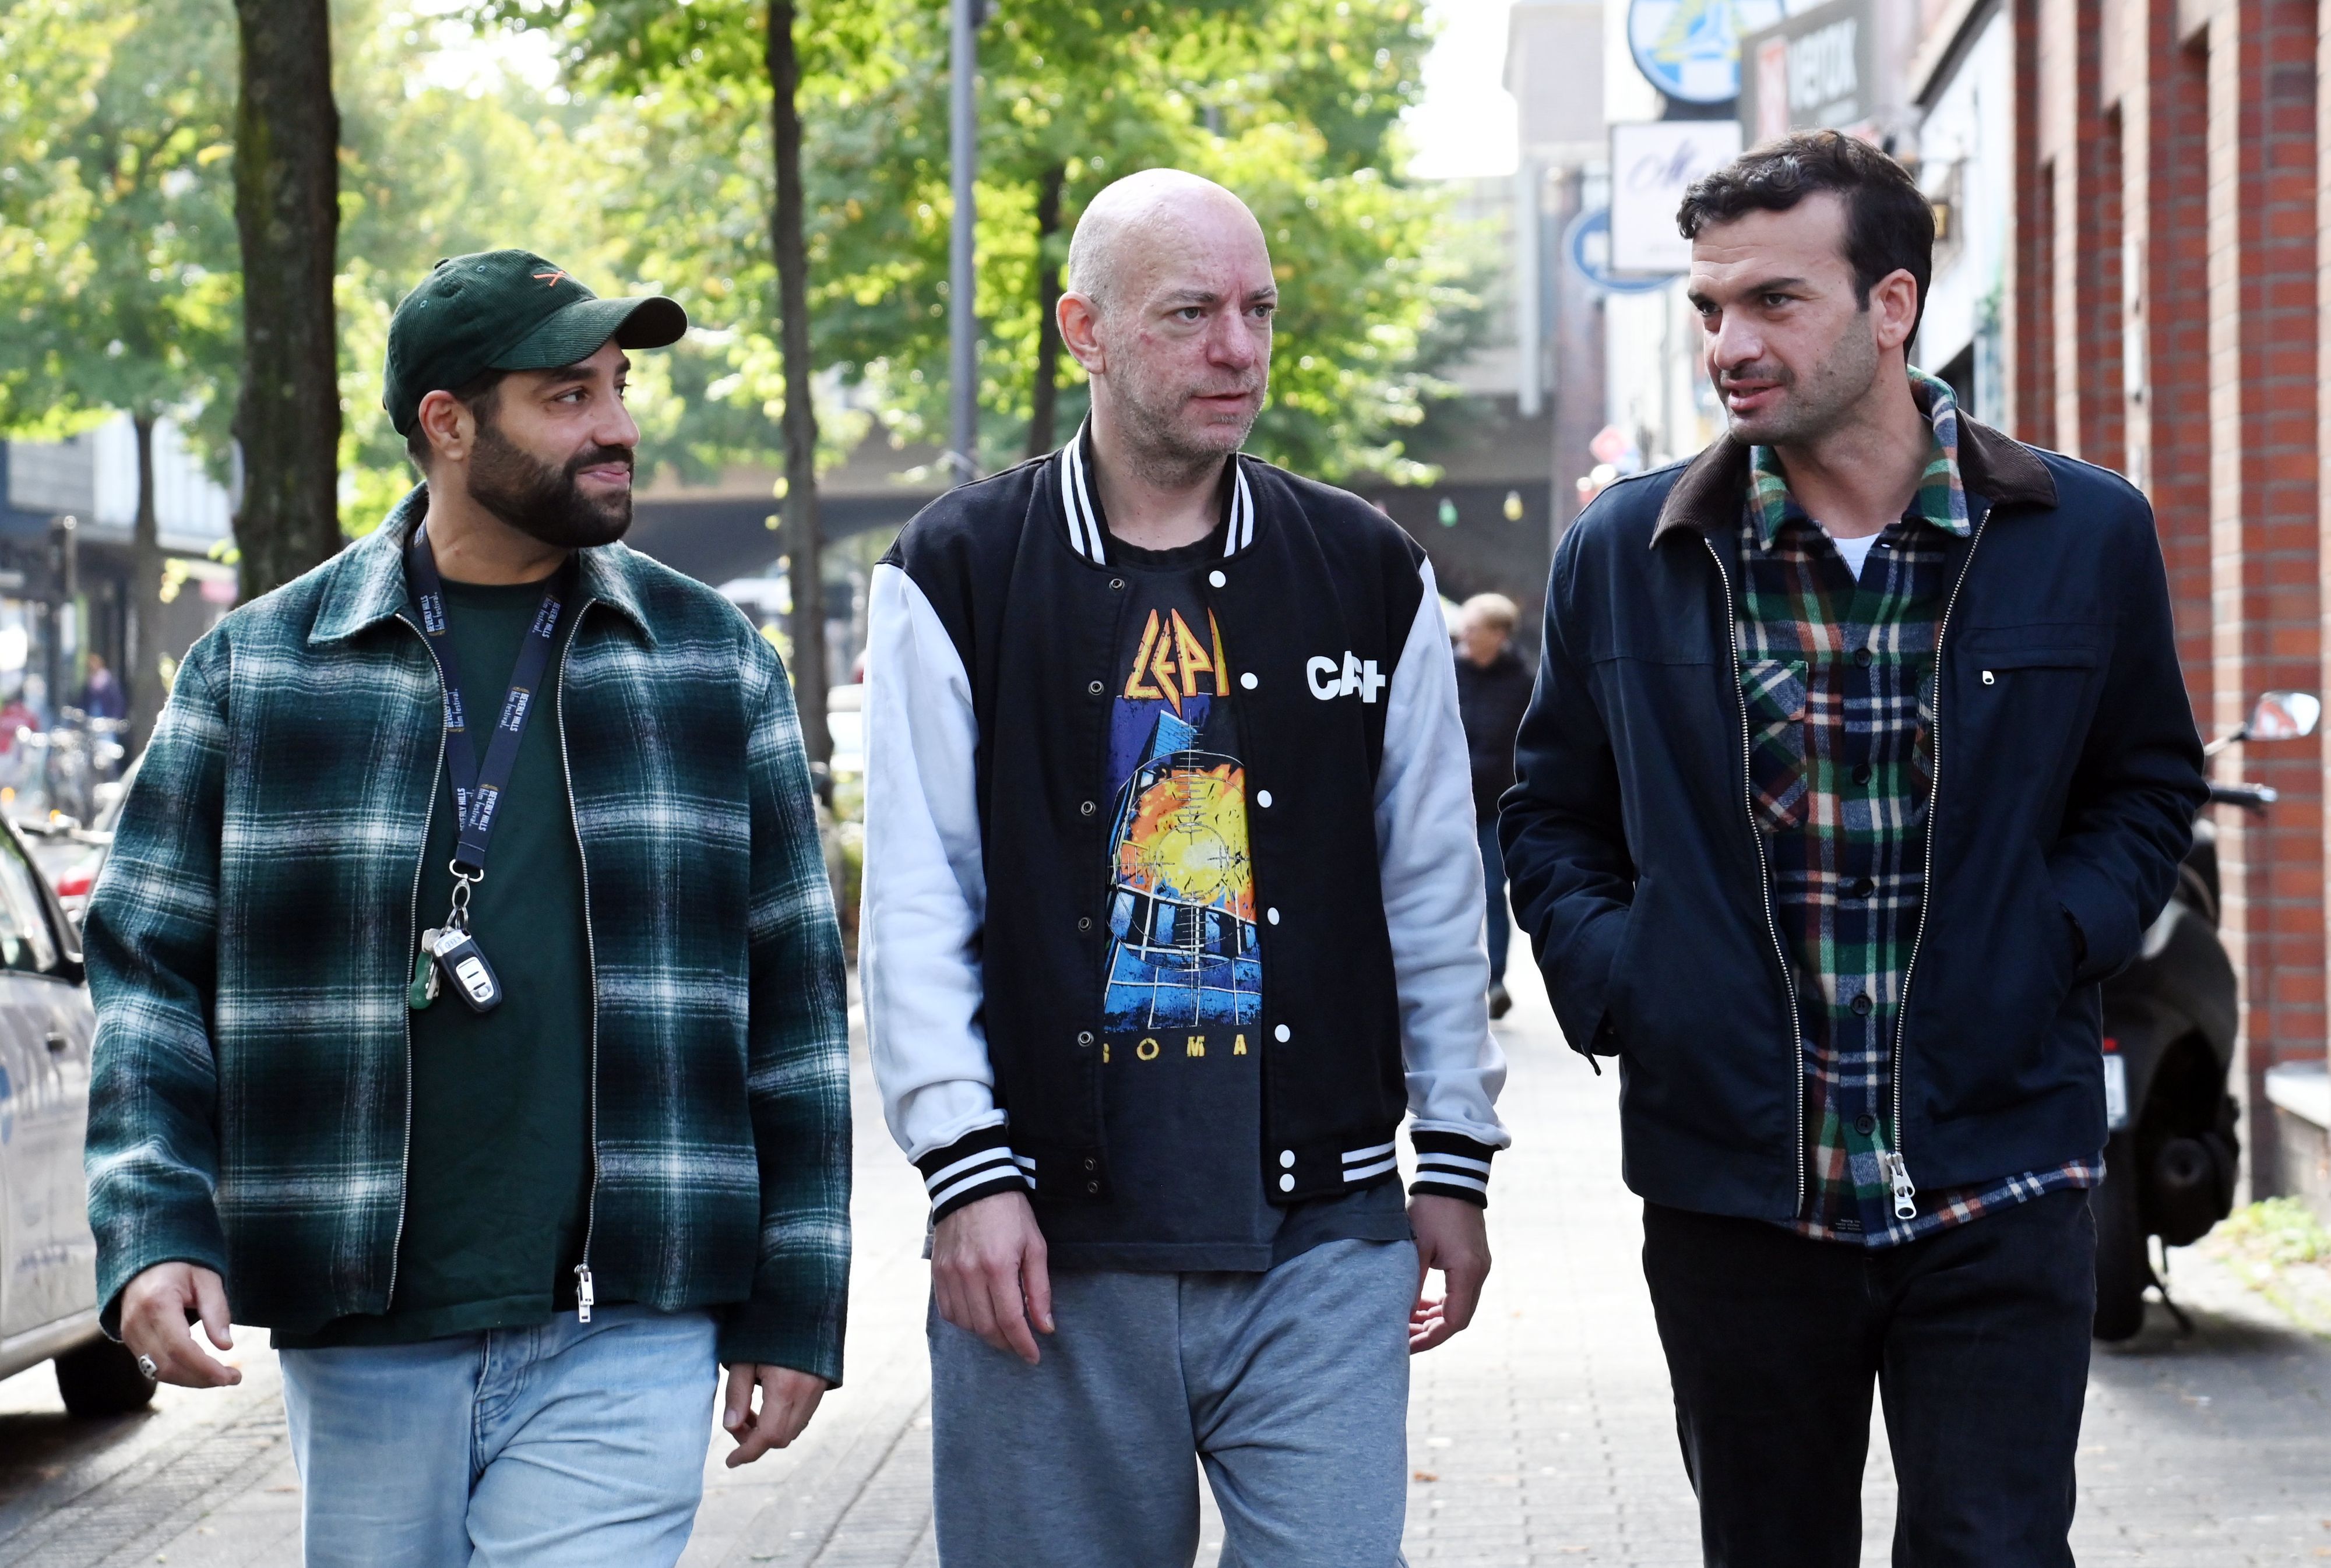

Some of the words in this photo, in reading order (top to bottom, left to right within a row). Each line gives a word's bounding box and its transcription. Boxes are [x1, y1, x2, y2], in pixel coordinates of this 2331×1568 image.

[543, 597, 554, 609] film
[548, 601, 561, 624] BEVERLY
[423, 611, 435, 632] BEVERLY
[435, 618, 445, 630] film
[542, 622, 553, 639] HILLS
[509, 690, 521, 702] film
[515, 693, 529, 716] BEVERLY
[454, 716, 464, 727] film
[509, 716, 522, 732] HILLS
[457, 787, 466, 805] HILLS
[477, 788, 490, 800] film
[484, 790, 498, 816] BEVERLY
[478, 814, 490, 832] HILLS
